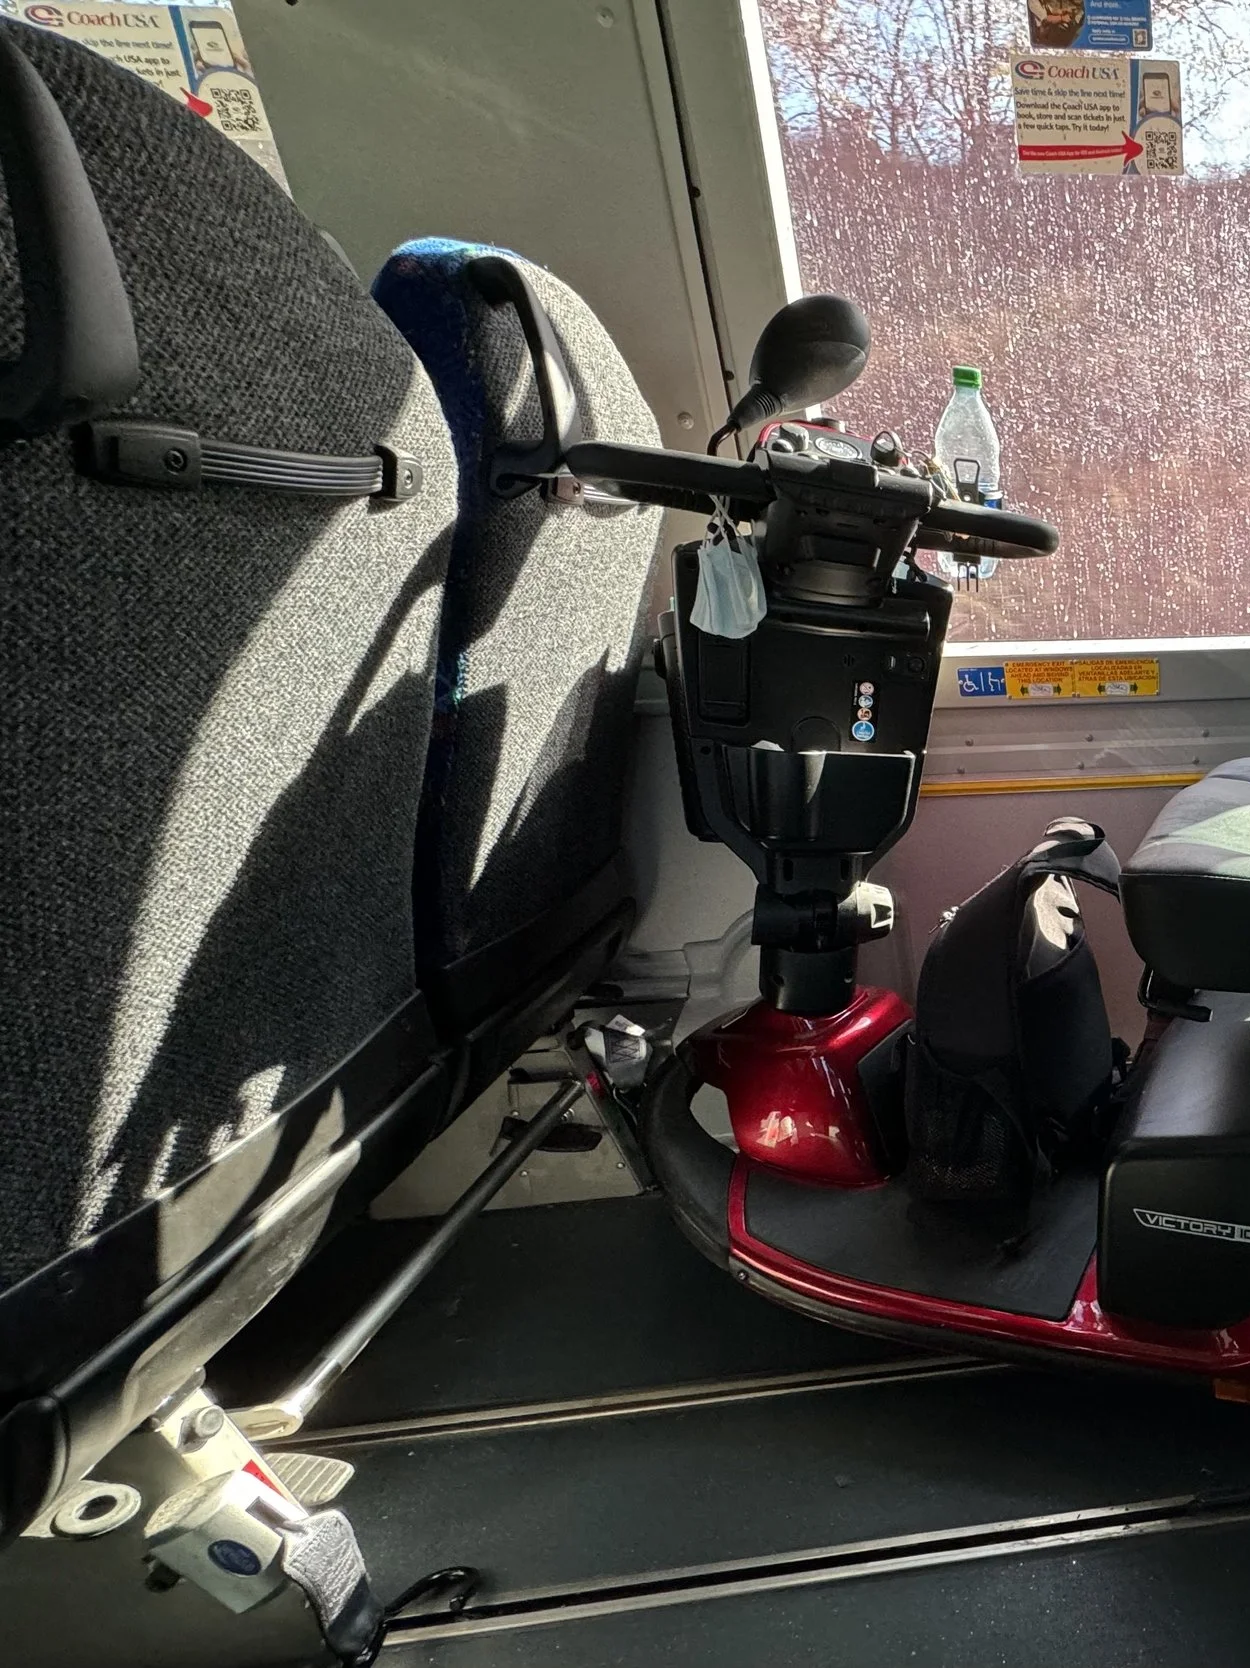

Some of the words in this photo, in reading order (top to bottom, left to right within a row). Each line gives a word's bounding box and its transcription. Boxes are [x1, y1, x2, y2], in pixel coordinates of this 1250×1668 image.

[67, 11, 121, 26] Coach
[123, 14, 160, 28] USA
[1048, 66, 1089, 78] Coach
[1092, 67, 1119, 80] USA
[1014, 88, 1030, 96] Save
[1031, 88, 1046, 96] time
[1047, 88, 1053, 96] &
[1054, 88, 1067, 97] skip
[1068, 88, 1079, 96] the
[1080, 89, 1092, 97] line
[1109, 90, 1125, 98] time!
[1016, 101, 1049, 110] Download
[1050, 102, 1061, 110] the
[1062, 102, 1082, 111] Coach
[1084, 103, 1098, 111] USA
[1017, 112, 1035, 120] book,
[1036, 112, 1052, 120] store
[1054, 112, 1066, 120] and
[1083, 113, 1104, 121] tickets
[1113, 114, 1125, 122] just
[1037, 123, 1054, 131] quick
[1055, 123, 1070, 131] taps.
[1072, 124, 1082, 132] Try
[1089, 124, 1109, 133] today!
[1146, 1213, 1232, 1236] VICTORY
